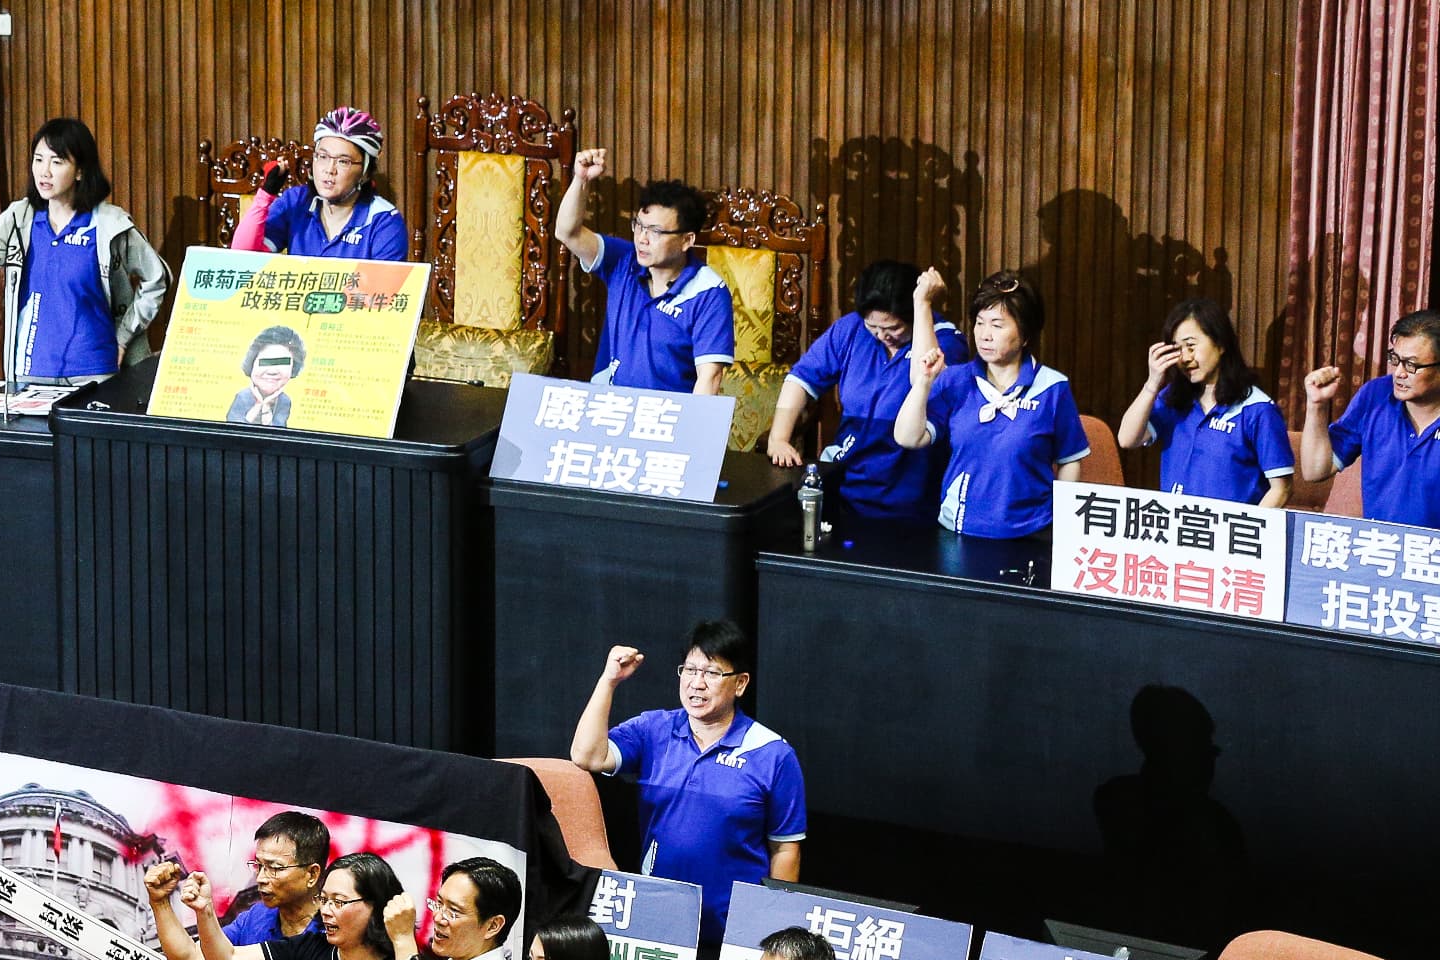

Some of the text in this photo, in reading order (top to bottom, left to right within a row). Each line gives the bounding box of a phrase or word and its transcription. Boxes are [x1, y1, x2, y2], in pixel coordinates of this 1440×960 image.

[64, 233, 91, 247] KMT
[193, 269, 361, 291] 陳菊高雄市府團隊
[656, 300, 682, 318] KMT
[534, 386, 682, 443] 廢考監
[1209, 416, 1236, 434] KMT
[543, 440, 691, 497] 拒投票
[1075, 492, 1266, 560] 有臉當官
[1301, 520, 1440, 584] 廢考監
[1073, 546, 1266, 616] 沒臉自清
[715, 752, 747, 769] KMT
